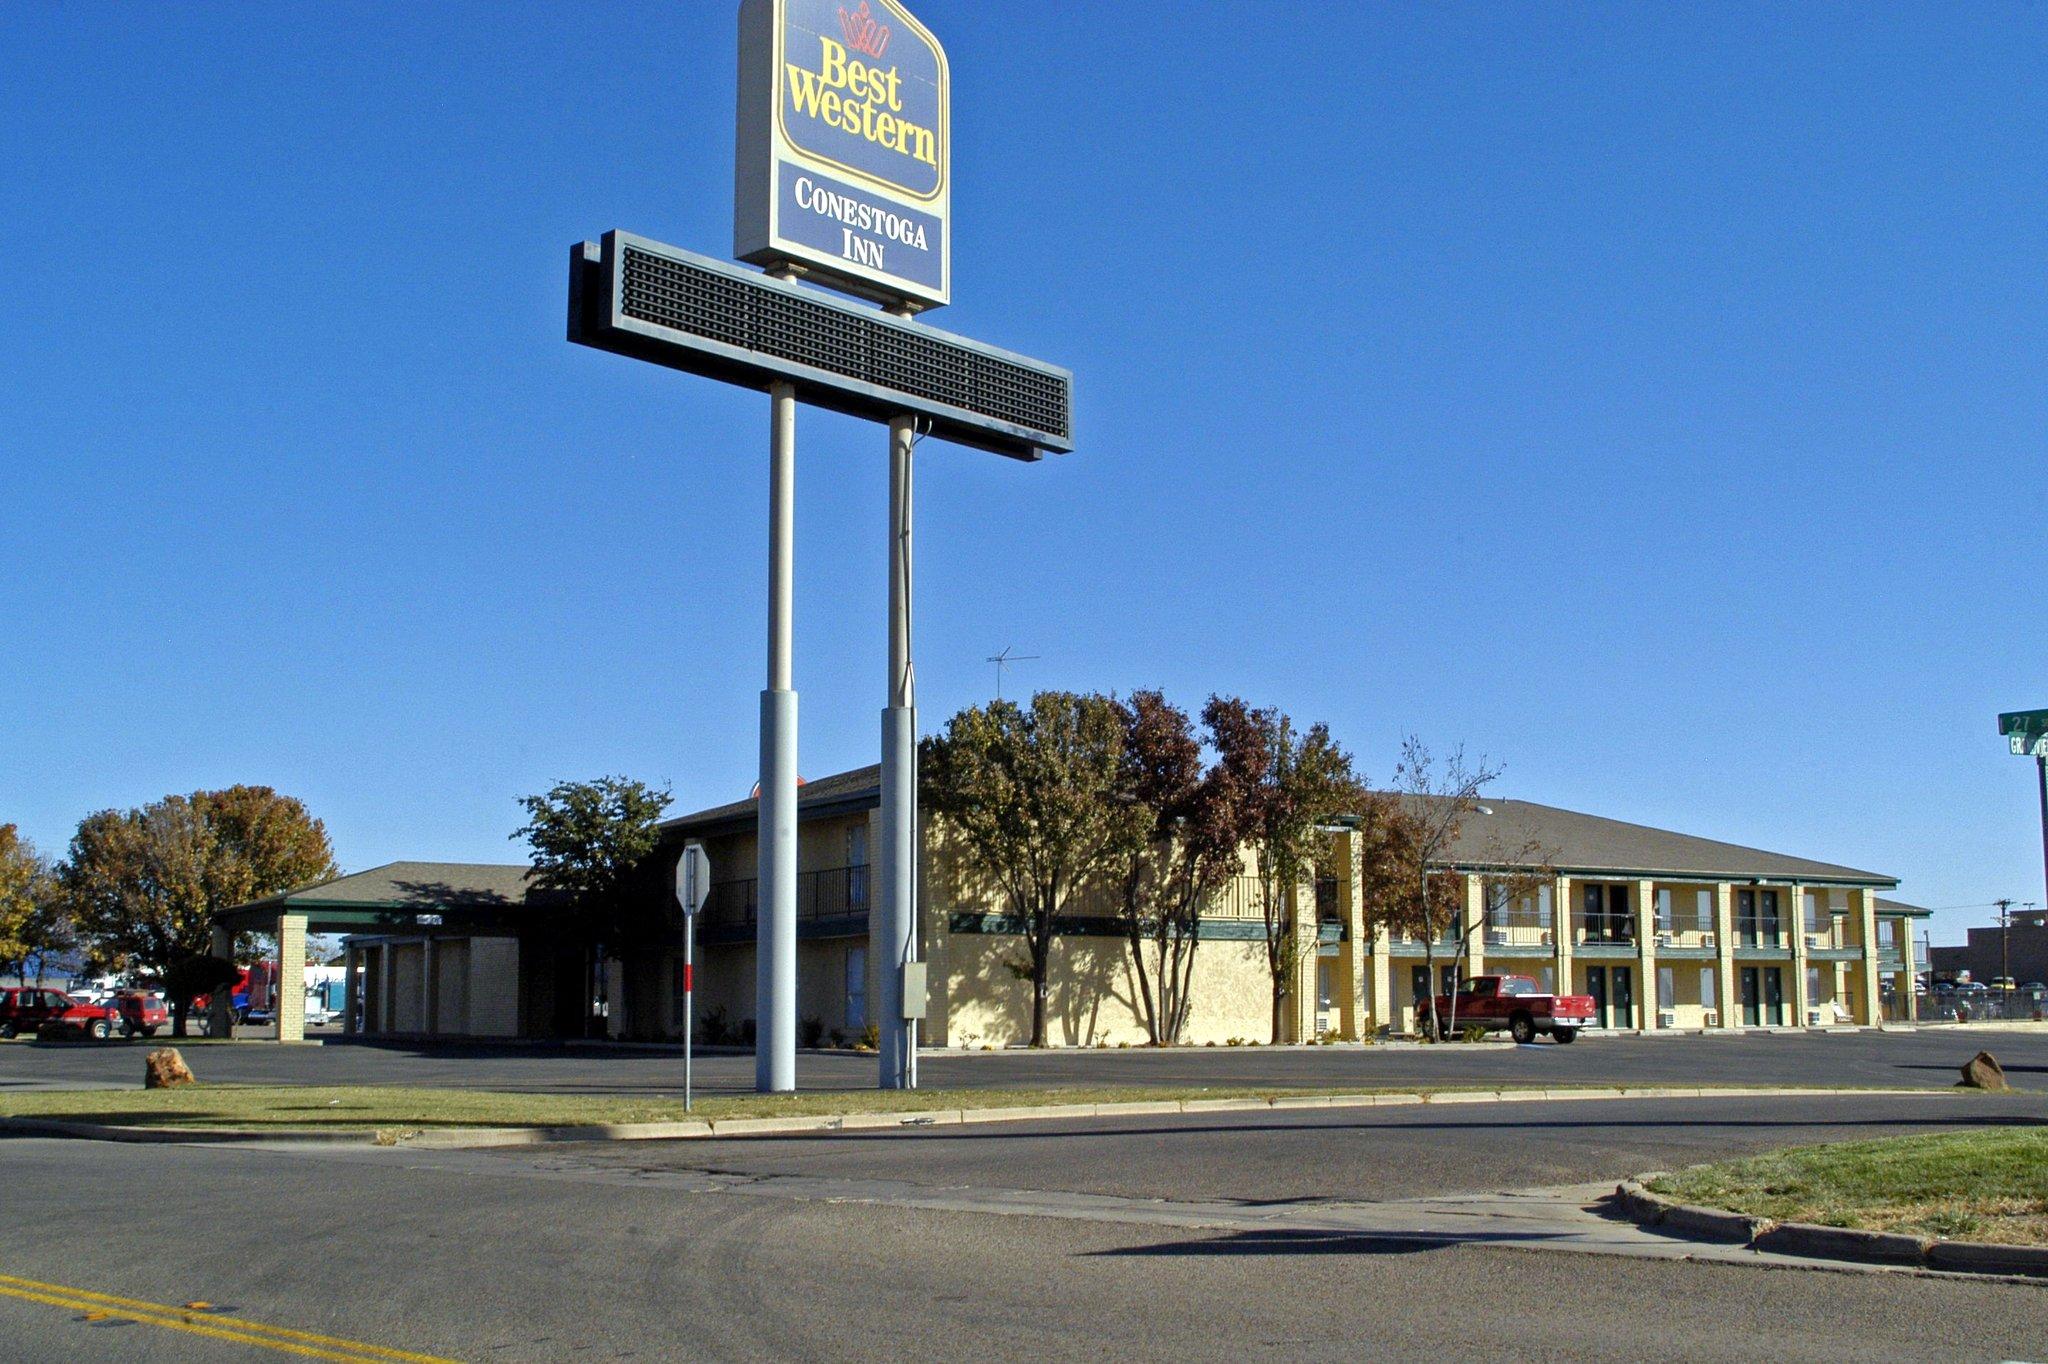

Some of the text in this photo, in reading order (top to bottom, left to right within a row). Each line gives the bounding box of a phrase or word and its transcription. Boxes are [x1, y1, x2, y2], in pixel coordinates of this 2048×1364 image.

[819, 35, 902, 112] Best
[785, 62, 937, 167] Western
[794, 176, 929, 251] CONESTOGA
[842, 227, 884, 270] INN
